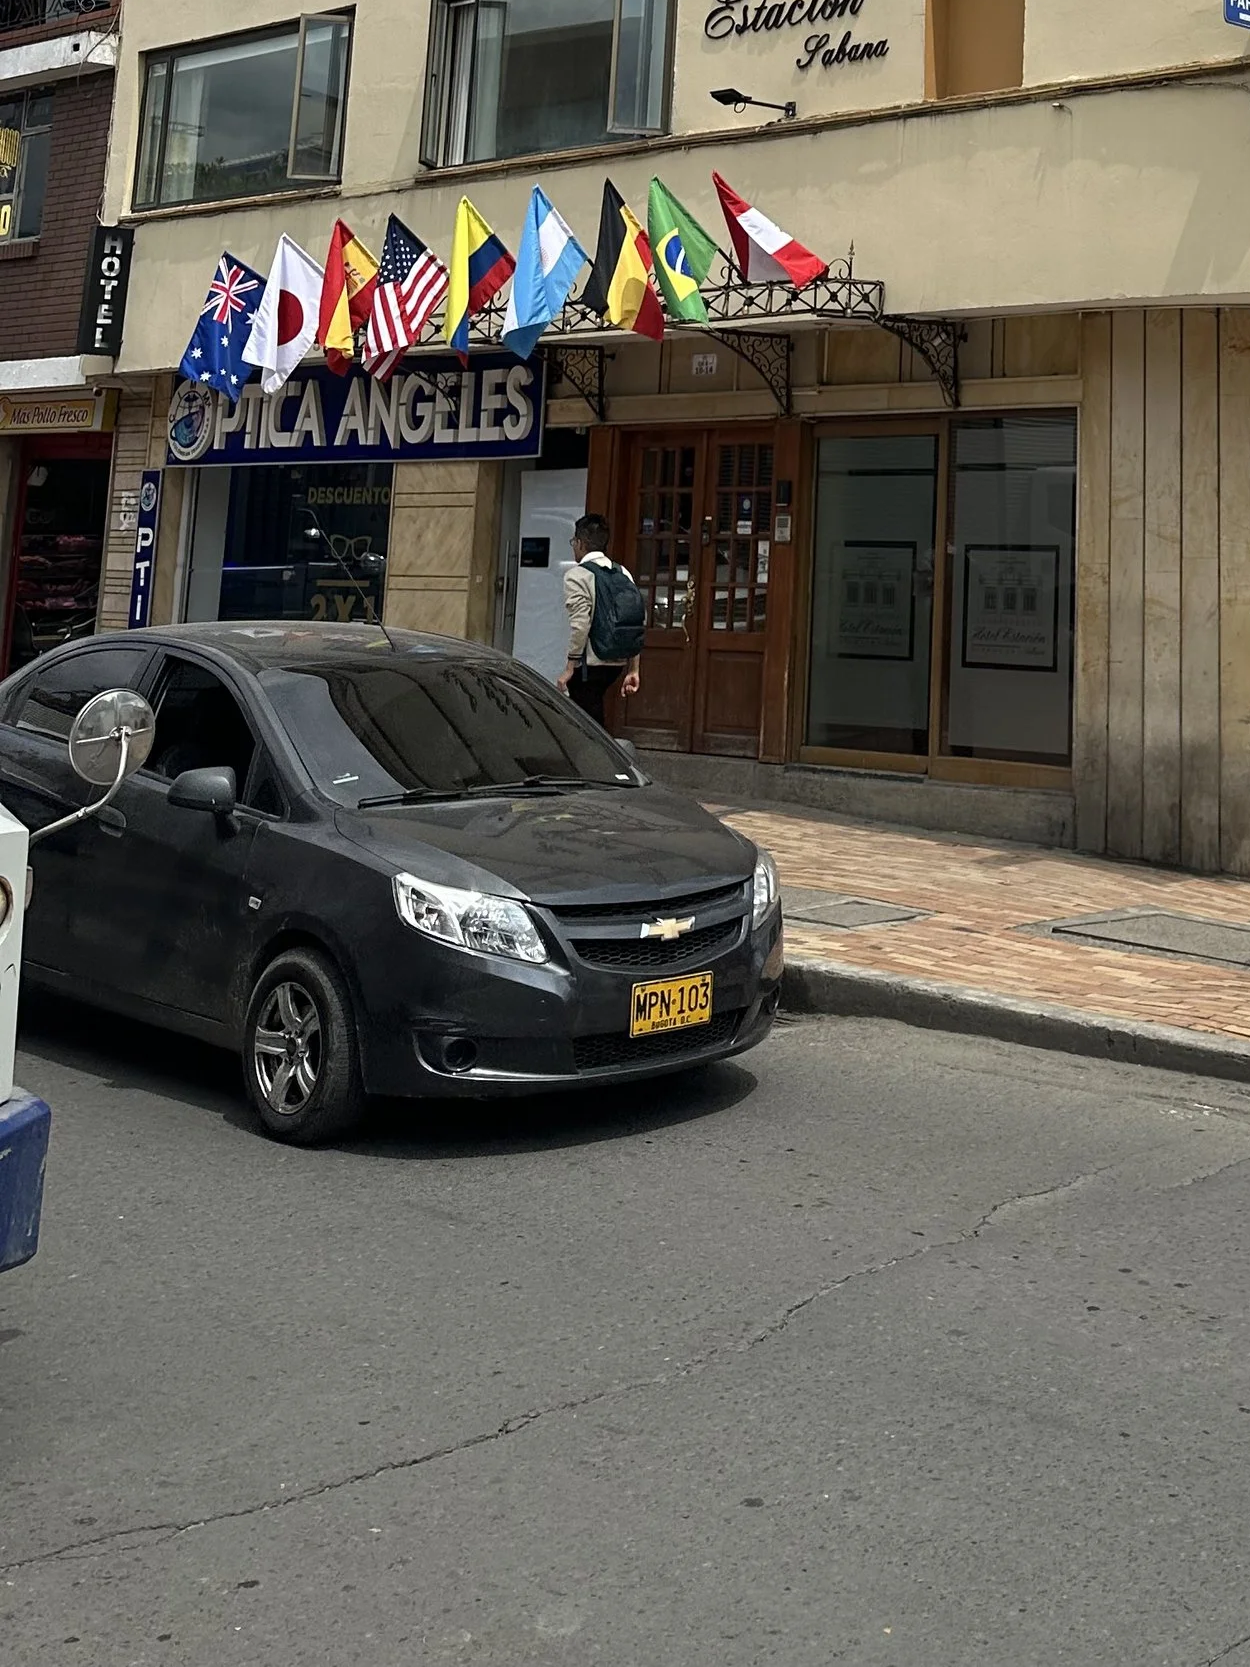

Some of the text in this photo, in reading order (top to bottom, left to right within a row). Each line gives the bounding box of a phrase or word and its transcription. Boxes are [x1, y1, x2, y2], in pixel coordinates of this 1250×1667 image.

[795, 30, 890, 69] Sabana
[94, 235, 124, 348] HOTEL
[10, 405, 89, 425] Más Pollo Fresco
[333, 364, 534, 449] ANGELES
[307, 486, 391, 505] DESCUENTO
[651, 1017, 677, 1030] BOGOTA
